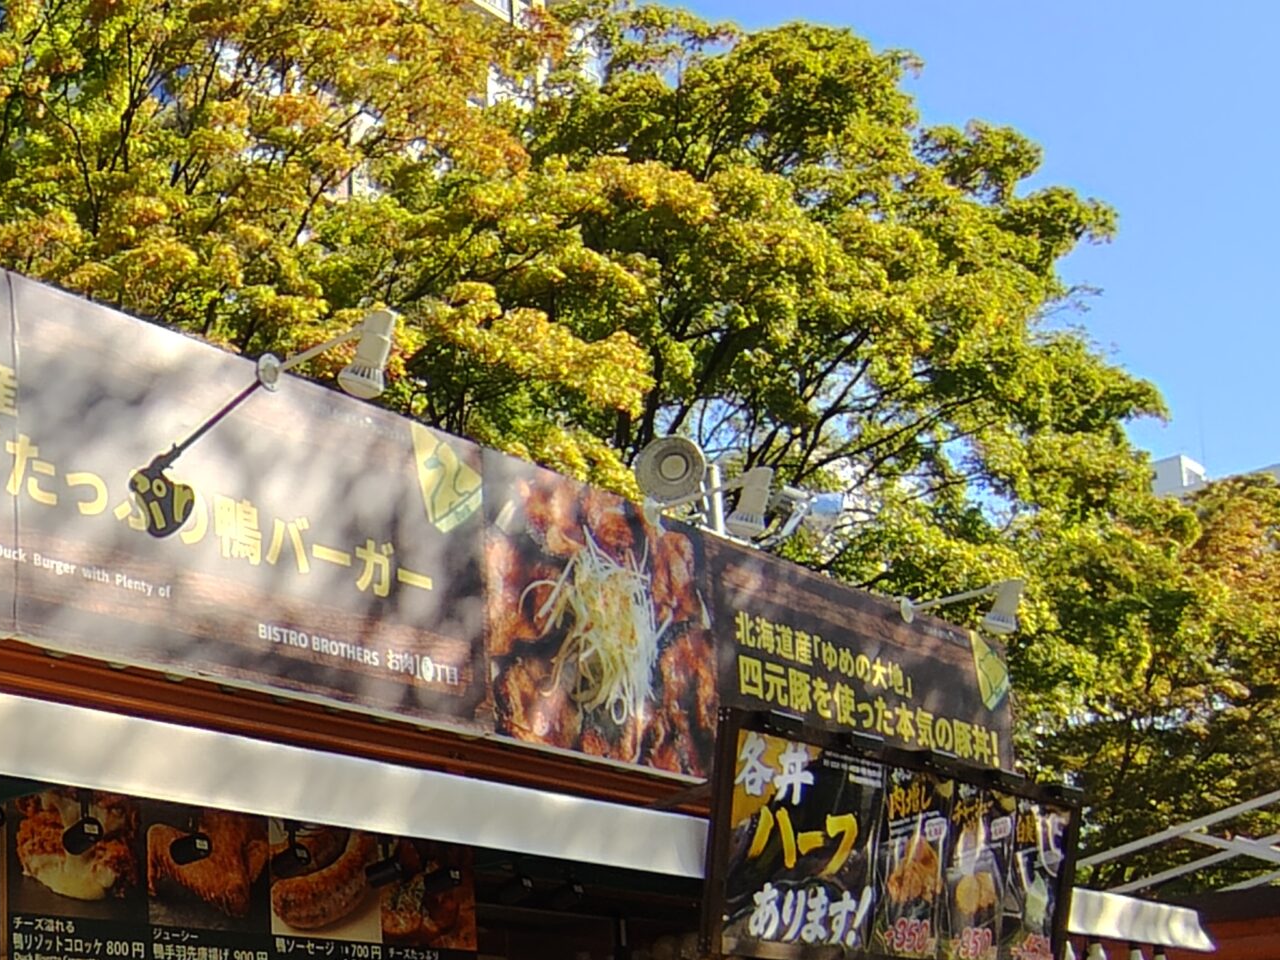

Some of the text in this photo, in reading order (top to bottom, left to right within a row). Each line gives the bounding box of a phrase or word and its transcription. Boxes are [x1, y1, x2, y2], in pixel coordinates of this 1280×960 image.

[33, 554, 77, 575] Burger
[82, 566, 110, 583] with
[115, 573, 153, 596] Plenty
[158, 585, 171, 598] of
[257, 623, 309, 648] BISTRO
[311, 636, 380, 666] BROTHERS
[734, 610, 913, 698] 北海道産「ゆめの大地」
[733, 730, 816, 807] 各丼
[747, 807, 859, 877] ハーフ
[12, 932, 105, 954] 鴨リゾットコロッケ
[153, 927, 199, 942] ジューシー
[275, 937, 335, 956] 鴨ソーセージ
